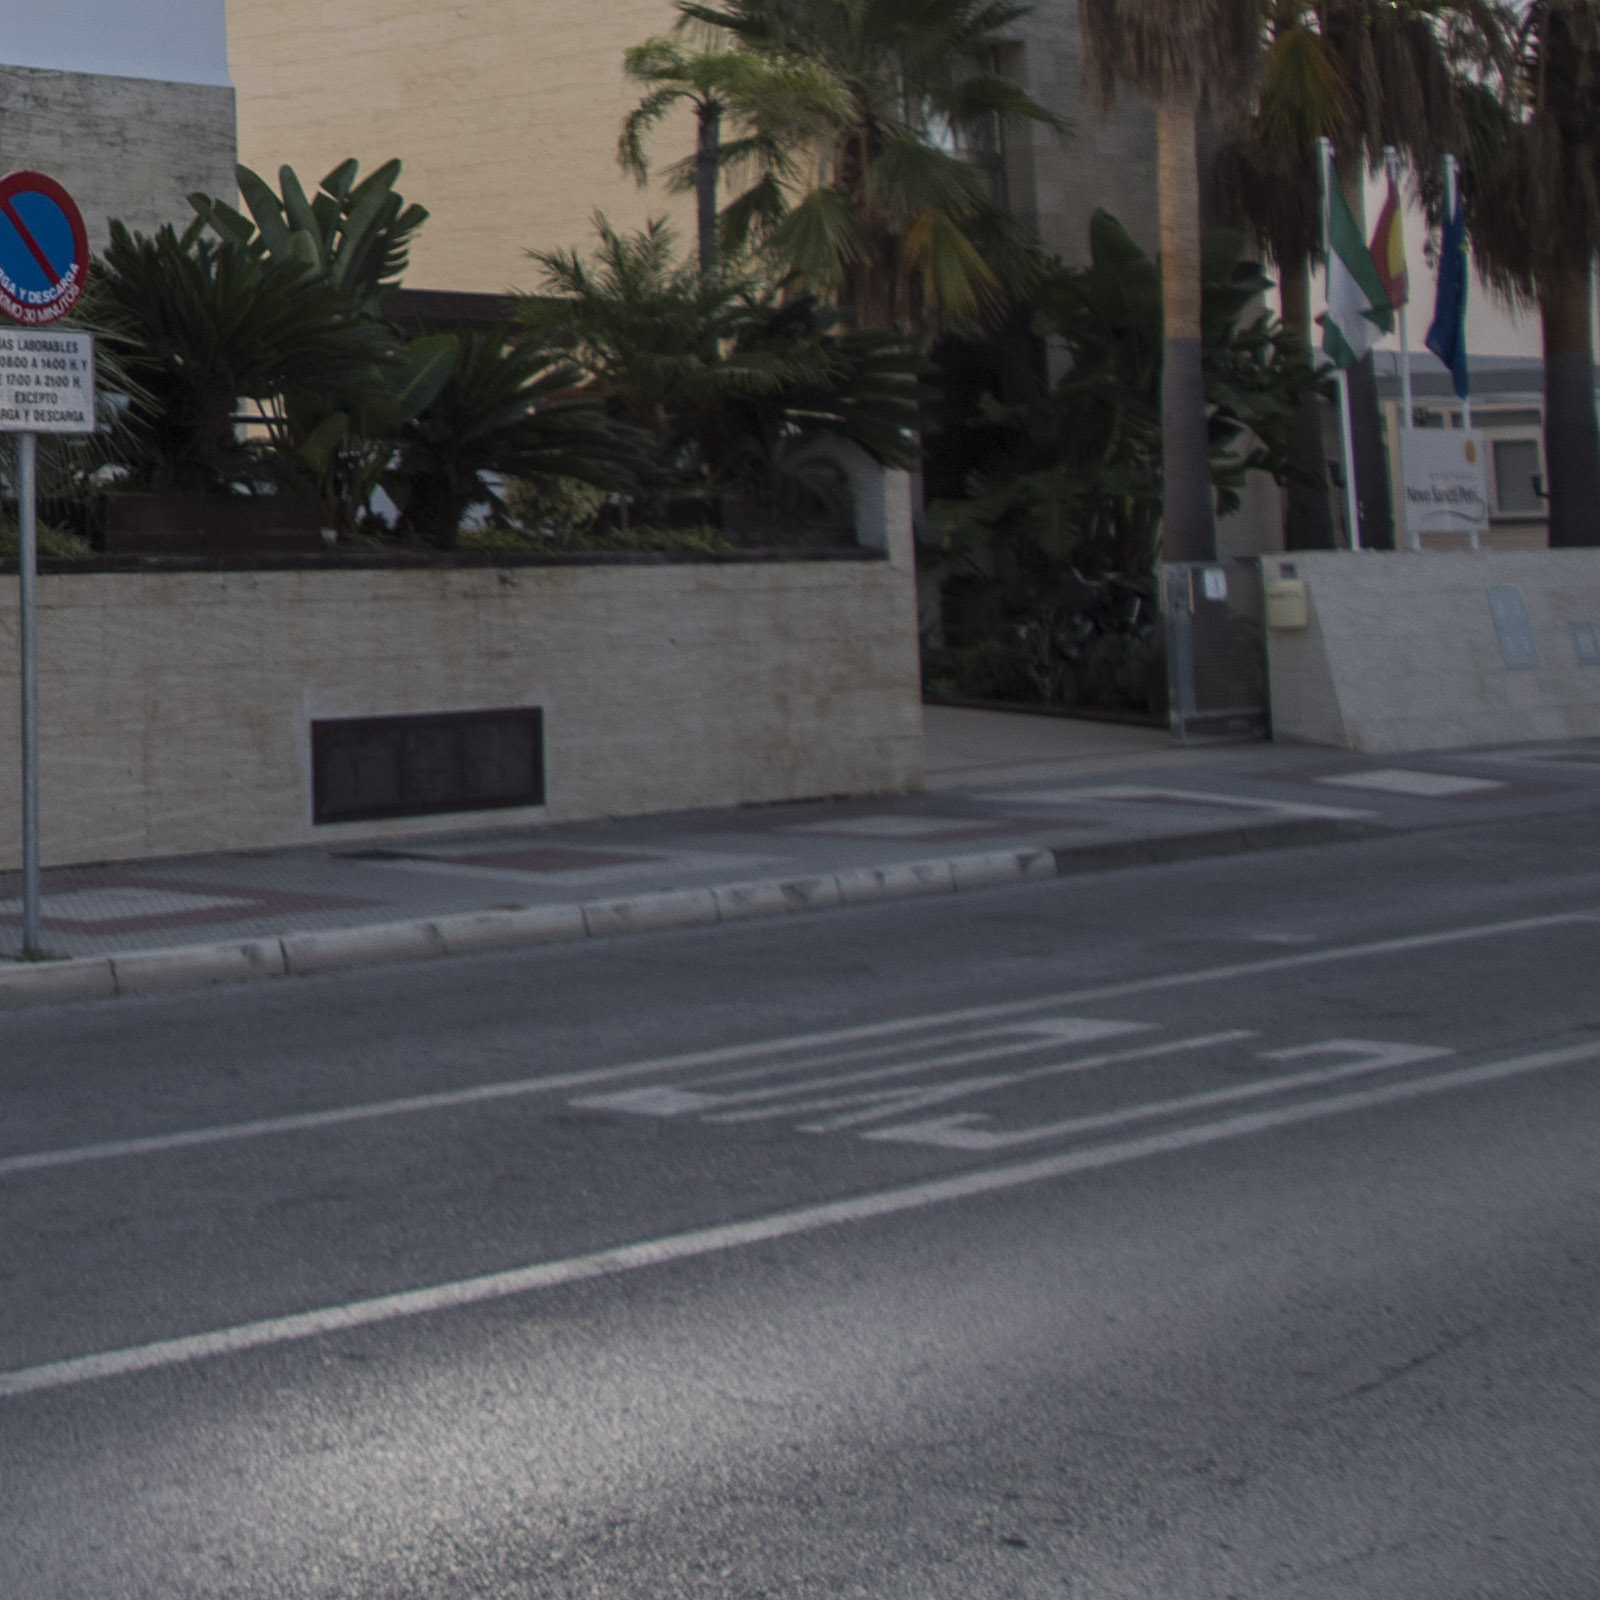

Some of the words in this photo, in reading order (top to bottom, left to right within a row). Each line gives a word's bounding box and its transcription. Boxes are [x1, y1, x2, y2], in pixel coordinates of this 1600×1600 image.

[19, 287, 28, 300] Y
[27, 263, 79, 304] DESCARGA
[23, 308, 36, 323] 30
[36, 283, 80, 322] MINUTOS
[17, 339, 79, 354] LABORABLES
[30, 357, 39, 369] A
[81, 359, 88, 371] Y
[6, 373, 31, 387] 17:00
[34, 375, 42, 387] A
[14, 391, 58, 405] EXCEPTO
[22, 409, 30, 421] Y
[32, 409, 84, 422] DESCARGA
